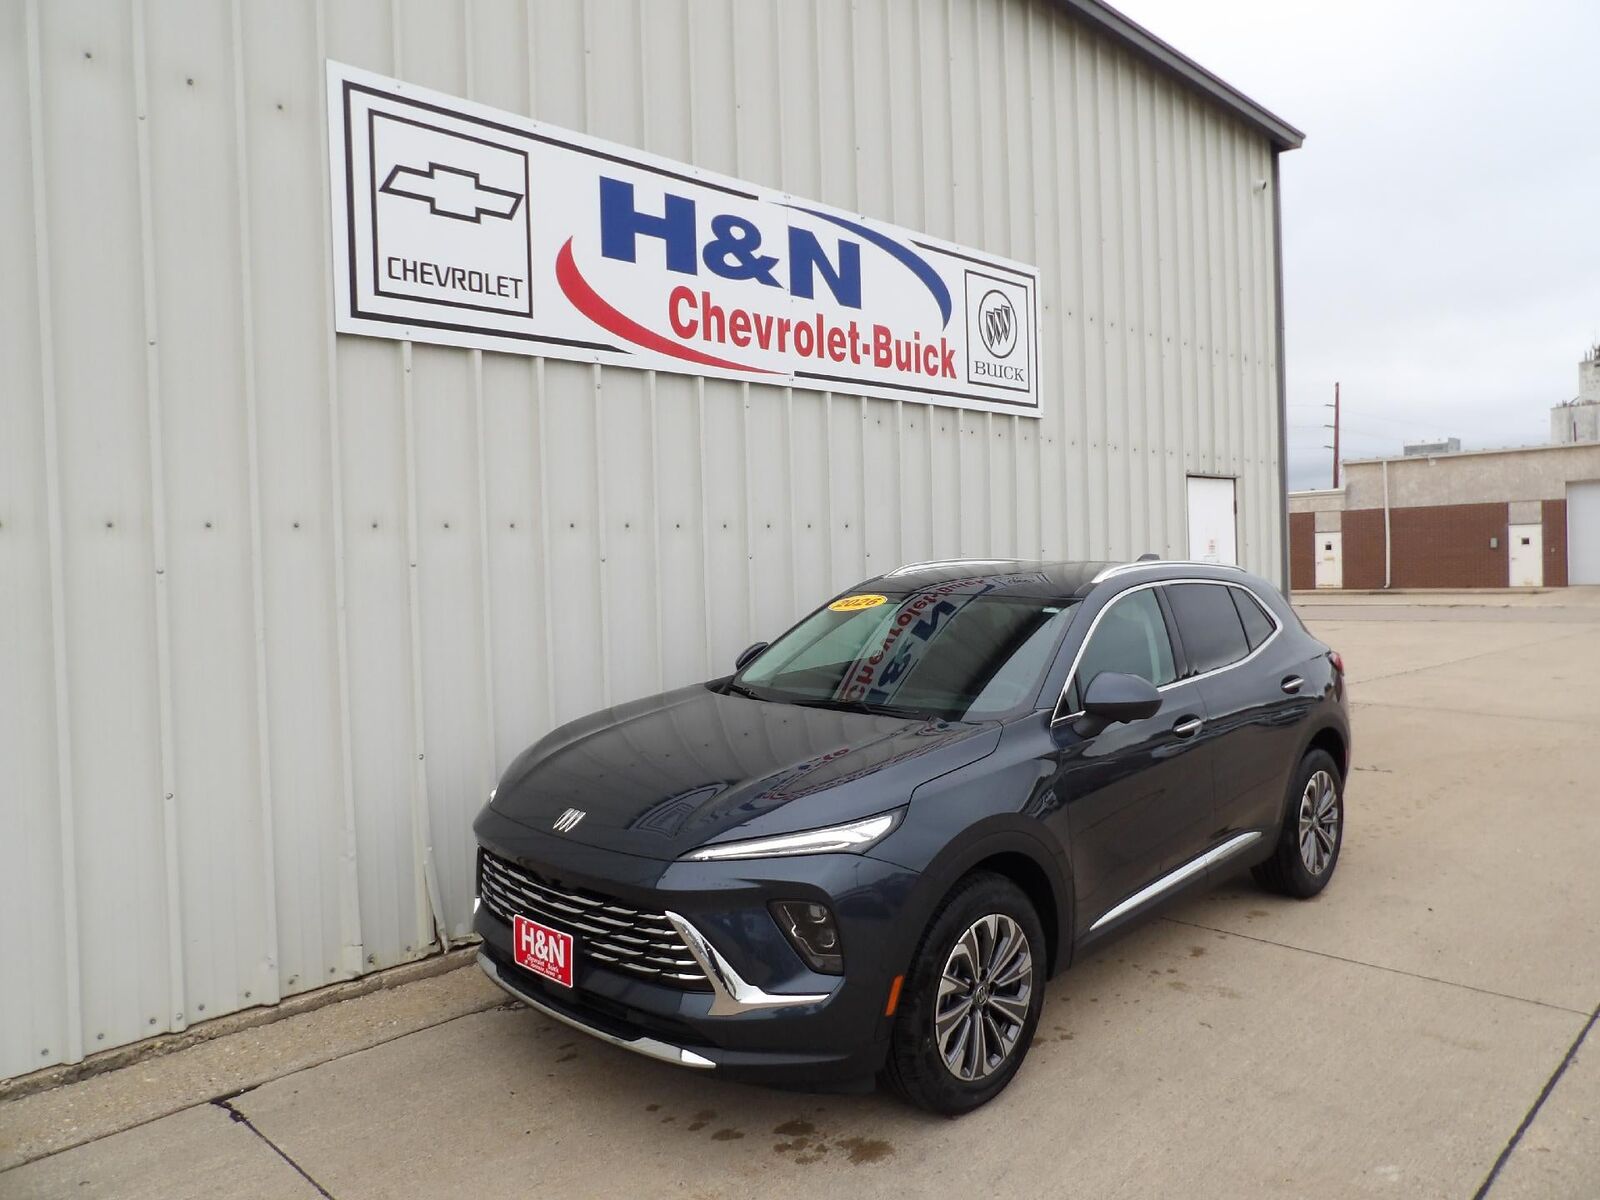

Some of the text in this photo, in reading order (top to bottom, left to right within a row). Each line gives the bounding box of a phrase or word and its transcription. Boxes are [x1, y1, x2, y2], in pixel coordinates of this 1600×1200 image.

[599, 175, 863, 310] H&N
[387, 256, 523, 299] CHEVROLET
[668, 285, 958, 380] Chevrolet-Buick
[974, 360, 1025, 382] BUICK
[831, 597, 882, 609] 2026
[521, 923, 565, 968] H&N
